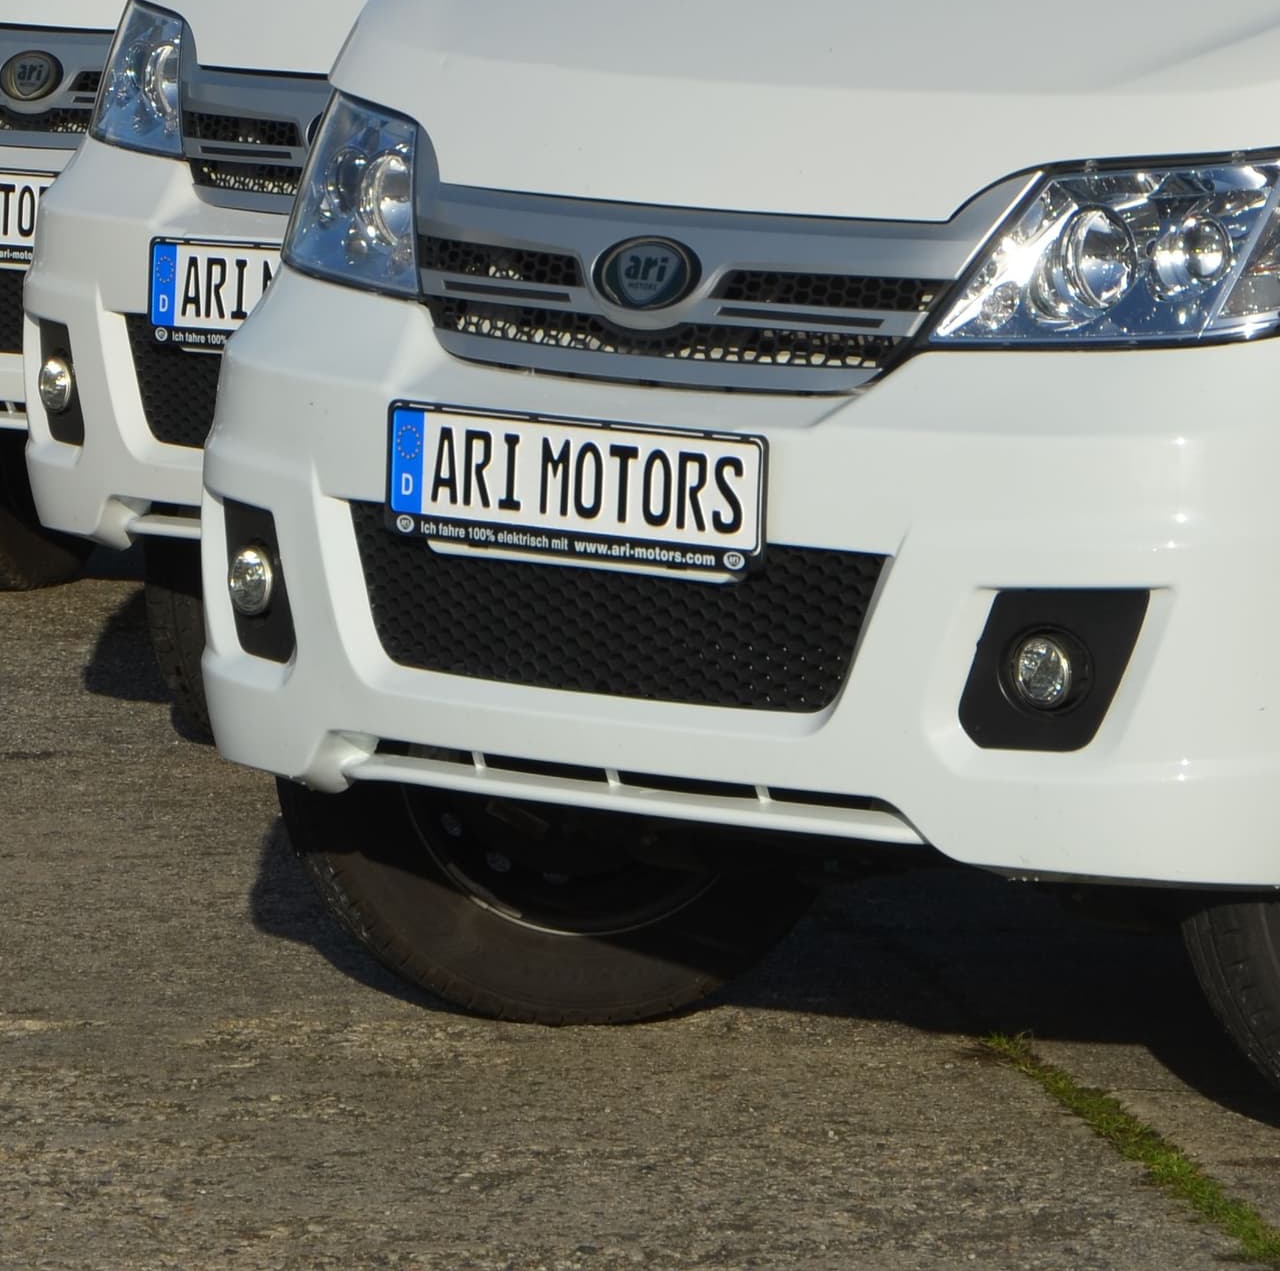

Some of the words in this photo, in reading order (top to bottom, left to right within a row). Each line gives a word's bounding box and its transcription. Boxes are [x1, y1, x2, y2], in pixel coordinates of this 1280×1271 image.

[17, 63, 45, 81] ari
[624, 255, 670, 282] ari
[181, 256, 248, 320] ARI
[159, 294, 168, 312] D
[172, 330, 184, 342] Ich
[185, 332, 206, 343] fahre
[401, 473, 414, 496] D
[431, 426, 522, 511] ARI
[539, 436, 744, 535] MOTORS
[420, 520, 437, 535] Ich
[438, 522, 466, 539] fahre
[467, 527, 496, 542] 100%
[497, 531, 549, 548] elektrisch
[551, 537, 568, 551] mit
[573, 540, 716, 567] www.ari-motors.com
